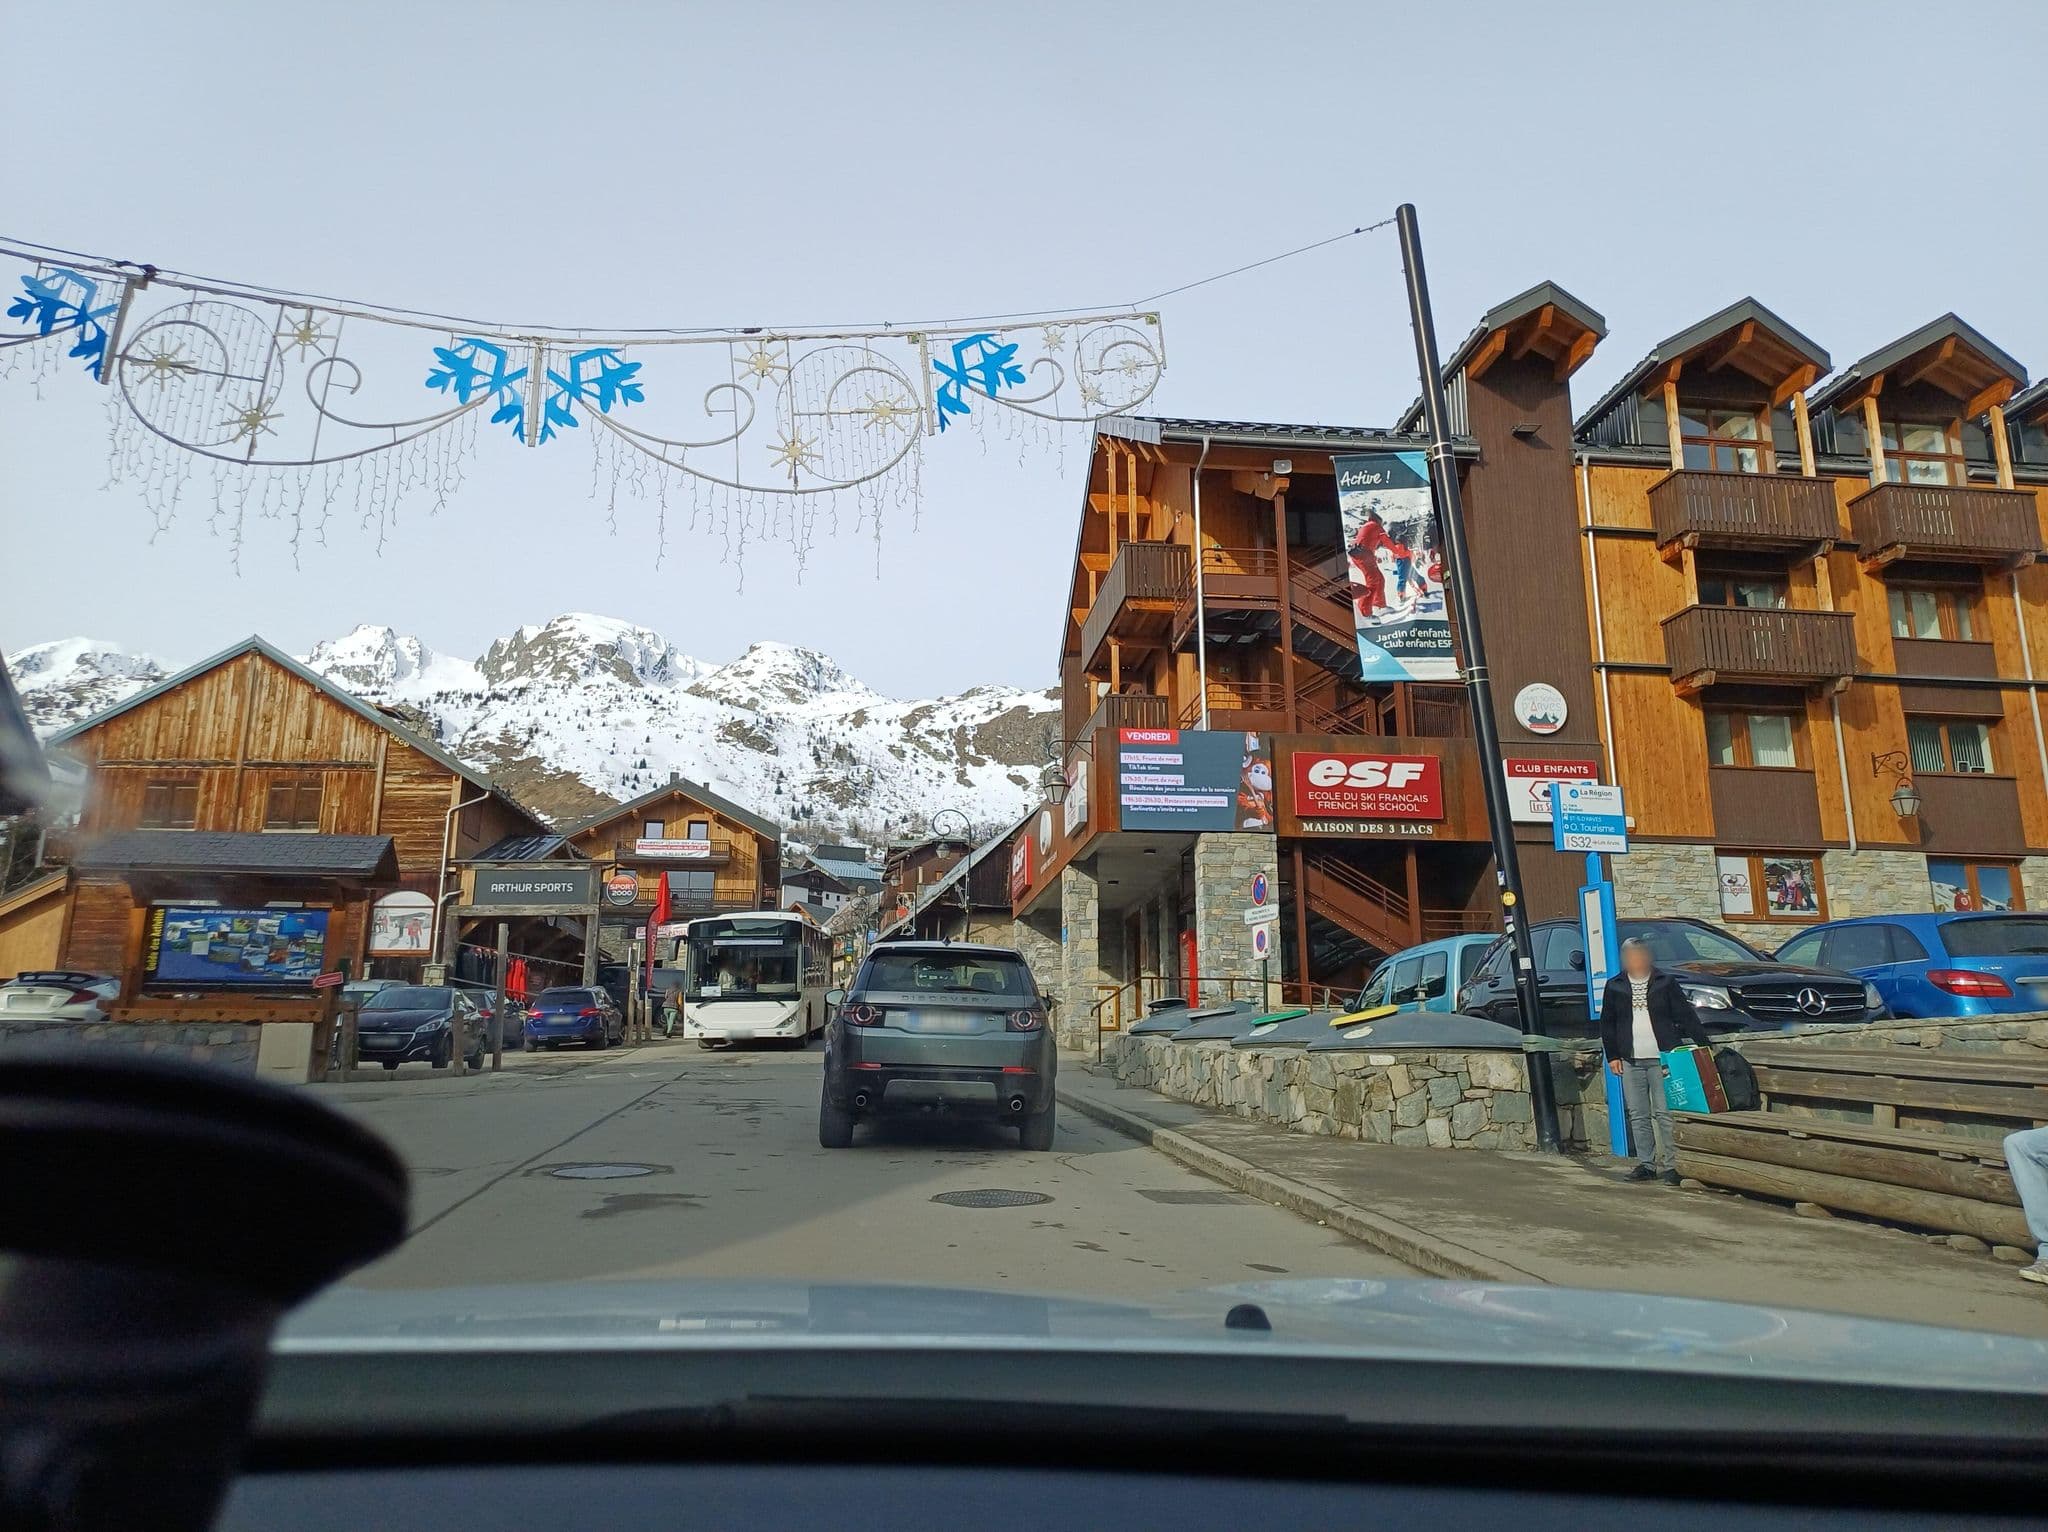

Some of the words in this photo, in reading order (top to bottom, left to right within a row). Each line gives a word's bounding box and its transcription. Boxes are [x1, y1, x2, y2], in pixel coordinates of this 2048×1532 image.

[1340, 469, 1382, 487] Active
[1385, 470, 1391, 484] !
[1376, 628, 1408, 643] Jardin
[1410, 627, 1451, 638] d'enfants
[1383, 640, 1405, 649] Club
[1406, 638, 1437, 648] enfants
[1438, 639, 1453, 648] ESF
[1126, 731, 1171, 741] VENDREDI
[1515, 764, 1541, 773] CLUB
[1543, 765, 1589, 774] ENFANTS
[1308, 791, 1341, 801] ECOLE
[1343, 792, 1359, 801] DU
[1360, 793, 1376, 802] SKI
[1580, 788, 1588, 796] La
[1589, 788, 1613, 799] Région
[1317, 801, 1359, 811] FRENCH
[1360, 802, 1376, 811] SKI
[1379, 803, 1421, 812] SCHOOL
[1302, 822, 1354, 833] MAISON
[1359, 823, 1384, 834] DES
[1388, 825, 1396, 834] 3
[1401, 825, 1433, 835] LACS
[1569, 823, 1579, 832] O.
[1580, 823, 1616, 833] Tourisme
[1570, 836, 1592, 848] S32
[490, 883, 532, 893] ARTHUR
[534, 882, 574, 892] SPORTS
[902, 995, 992, 1003] DISCOVERY
